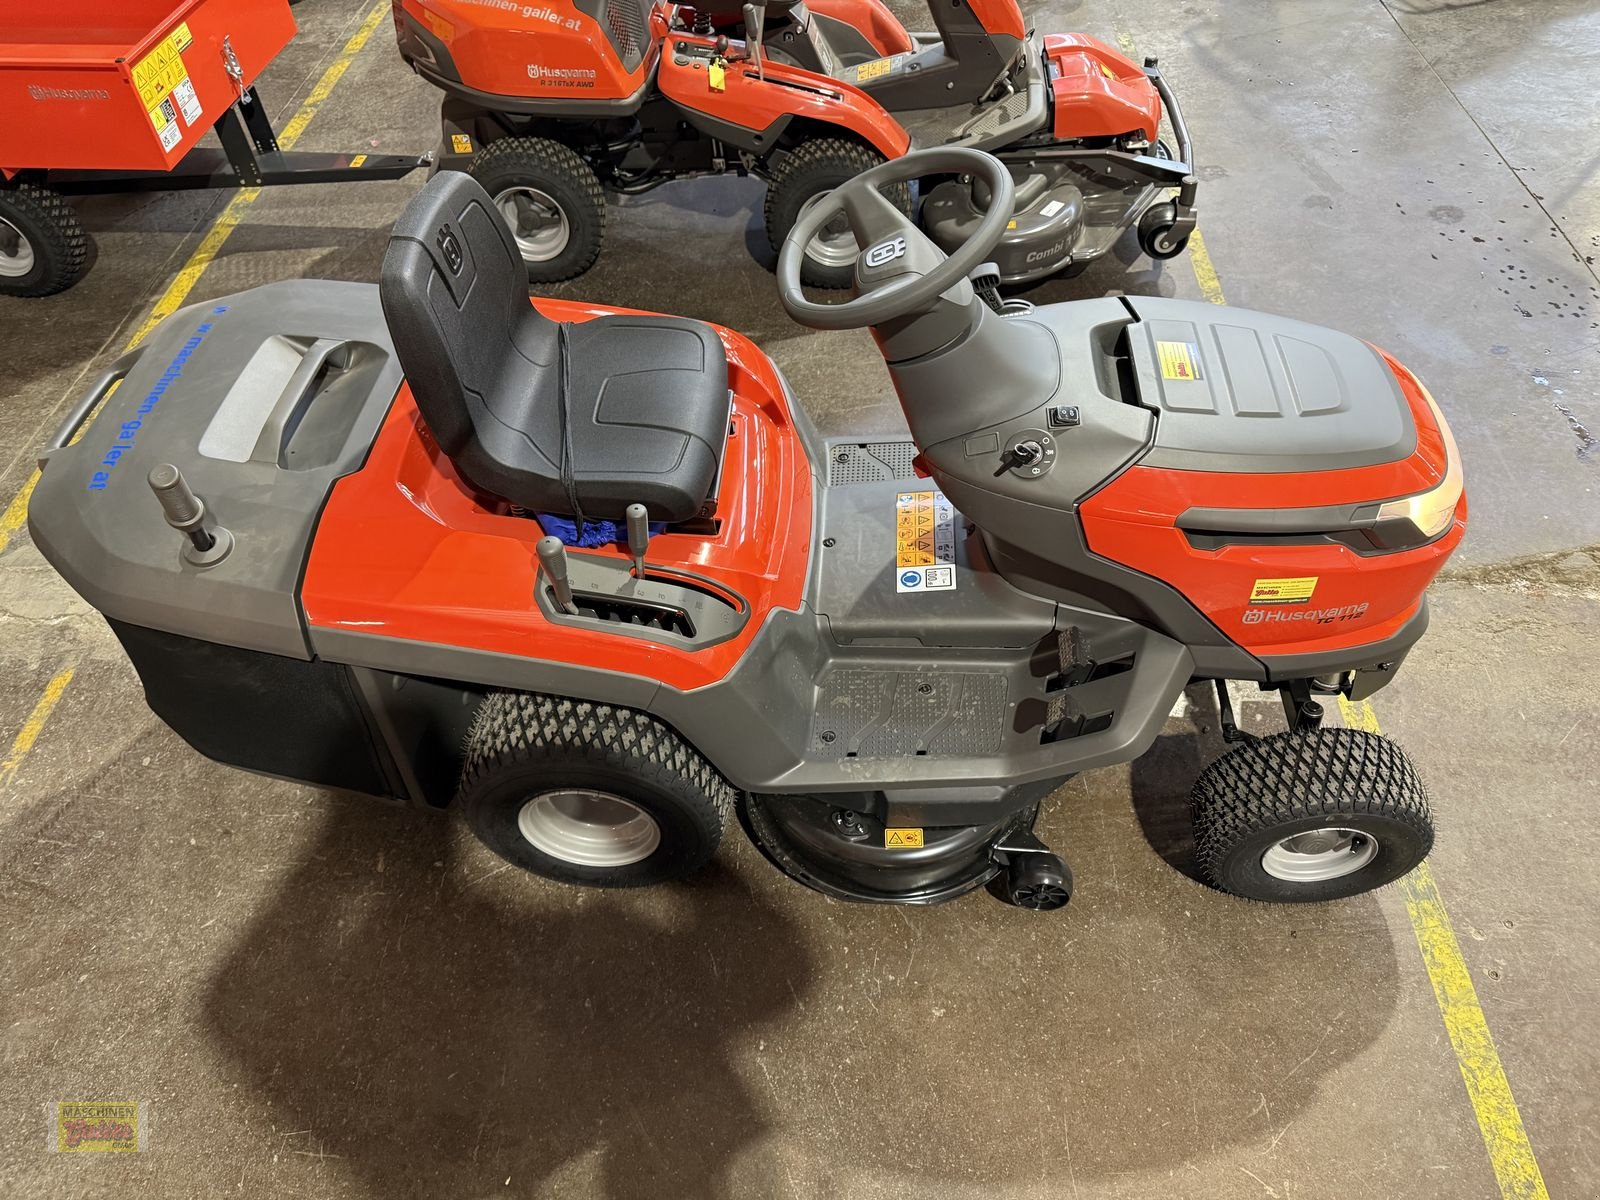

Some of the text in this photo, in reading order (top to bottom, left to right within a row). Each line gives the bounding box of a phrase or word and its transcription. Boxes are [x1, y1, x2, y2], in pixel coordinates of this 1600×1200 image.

[539, 66, 596, 79] Husqvarna
[1026, 239, 1064, 263] Combi
[1264, 601, 1369, 622] Husqvarna
[1338, 612, 1364, 622] 112
